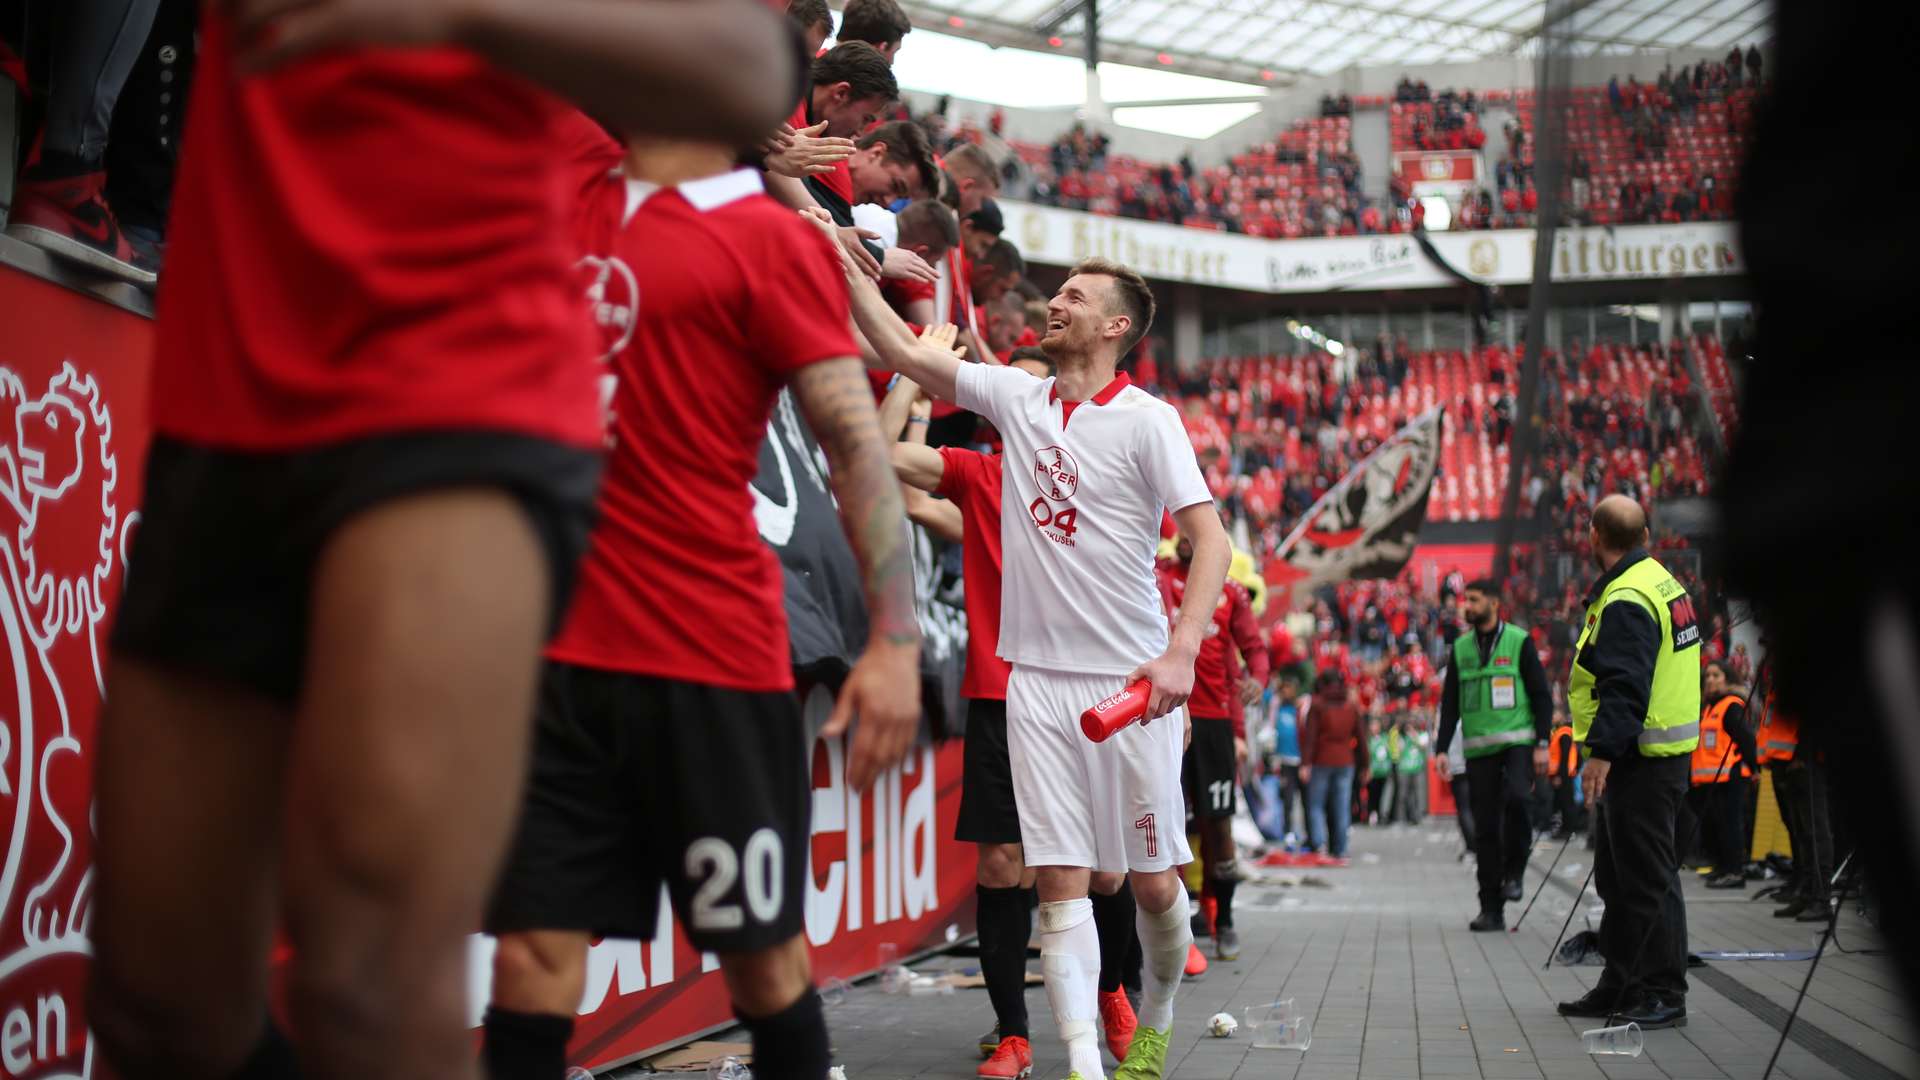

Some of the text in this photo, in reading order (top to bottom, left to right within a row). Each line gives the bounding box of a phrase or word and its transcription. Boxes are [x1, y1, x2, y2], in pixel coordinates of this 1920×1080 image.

[1531, 233, 1733, 274] itburger
[1030, 497, 1077, 537] 04
[1209, 780, 1232, 810] 11
[1136, 813, 1157, 857] 1
[685, 827, 784, 930] 20
